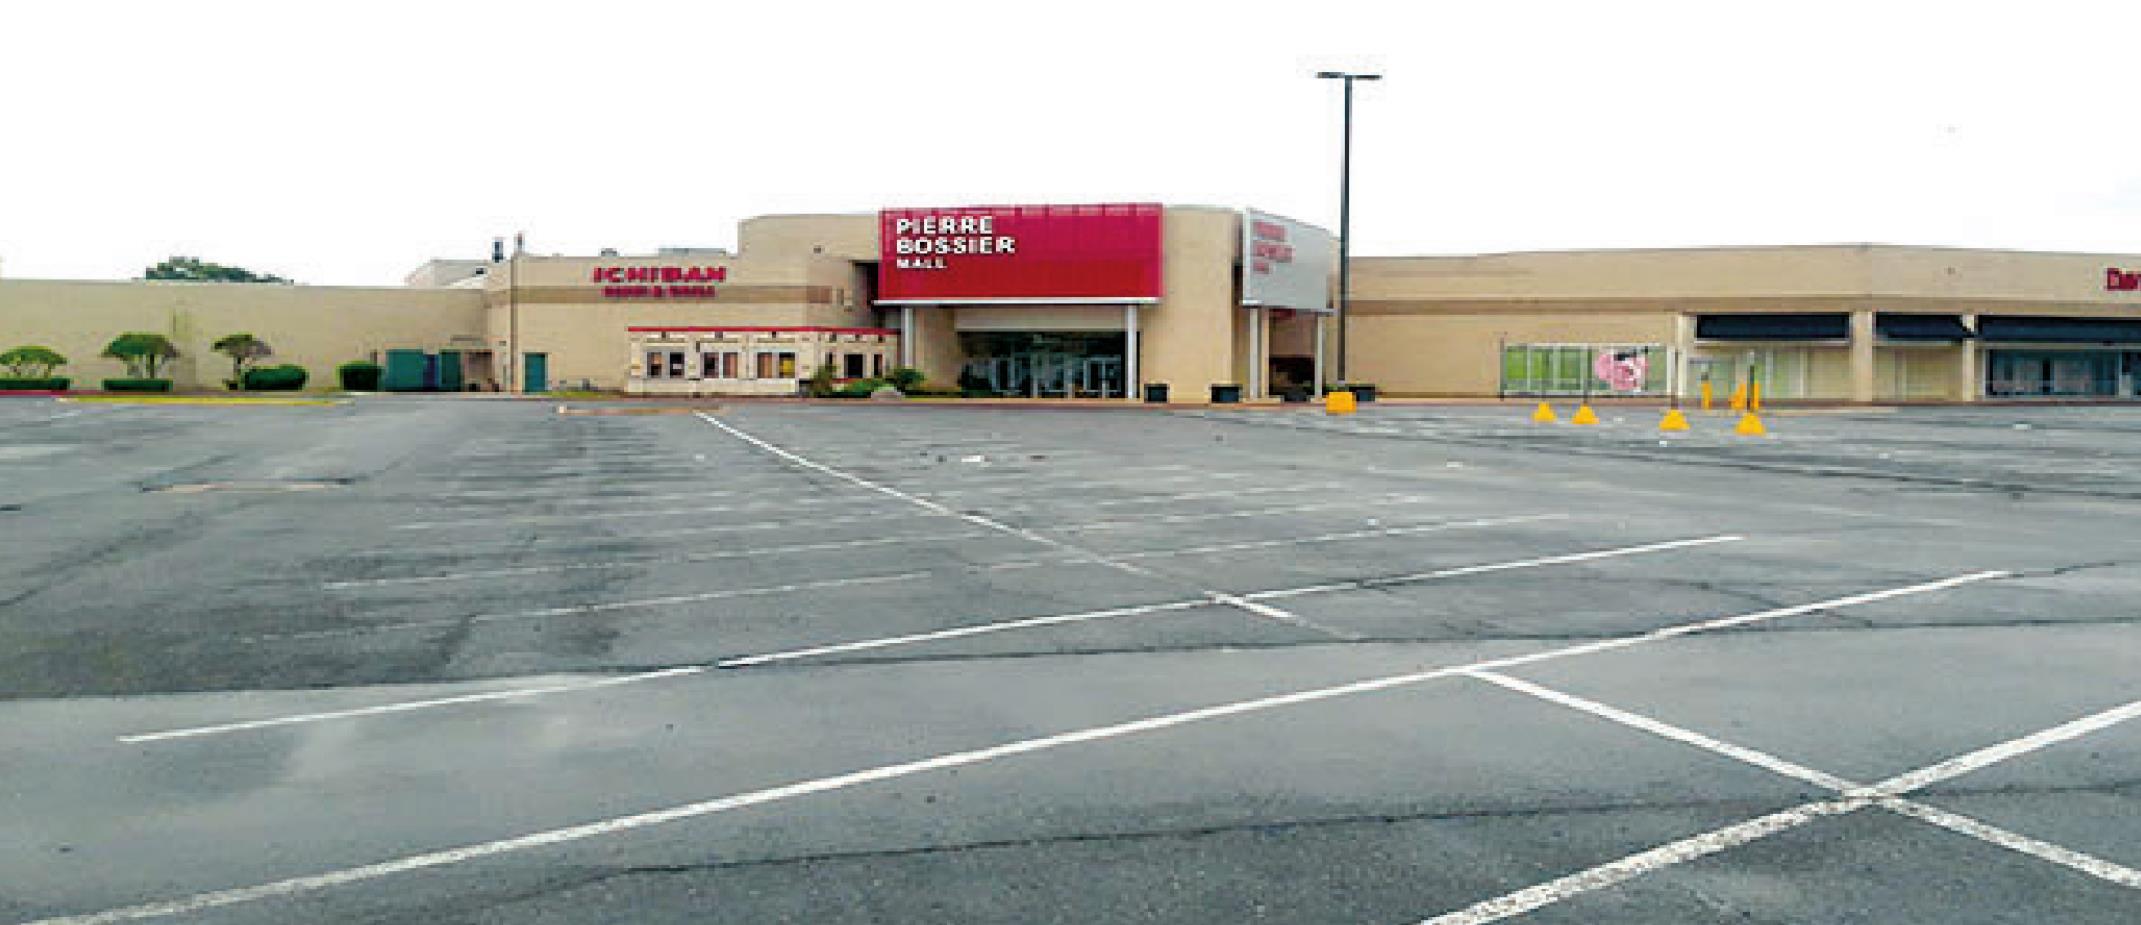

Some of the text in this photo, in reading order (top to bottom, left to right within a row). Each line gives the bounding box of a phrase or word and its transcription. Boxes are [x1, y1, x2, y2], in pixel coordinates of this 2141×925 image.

[896, 216, 994, 235] PIERRE
[896, 237, 1016, 254] BOSSIER
[593, 266, 727, 283] ICHIBAN
